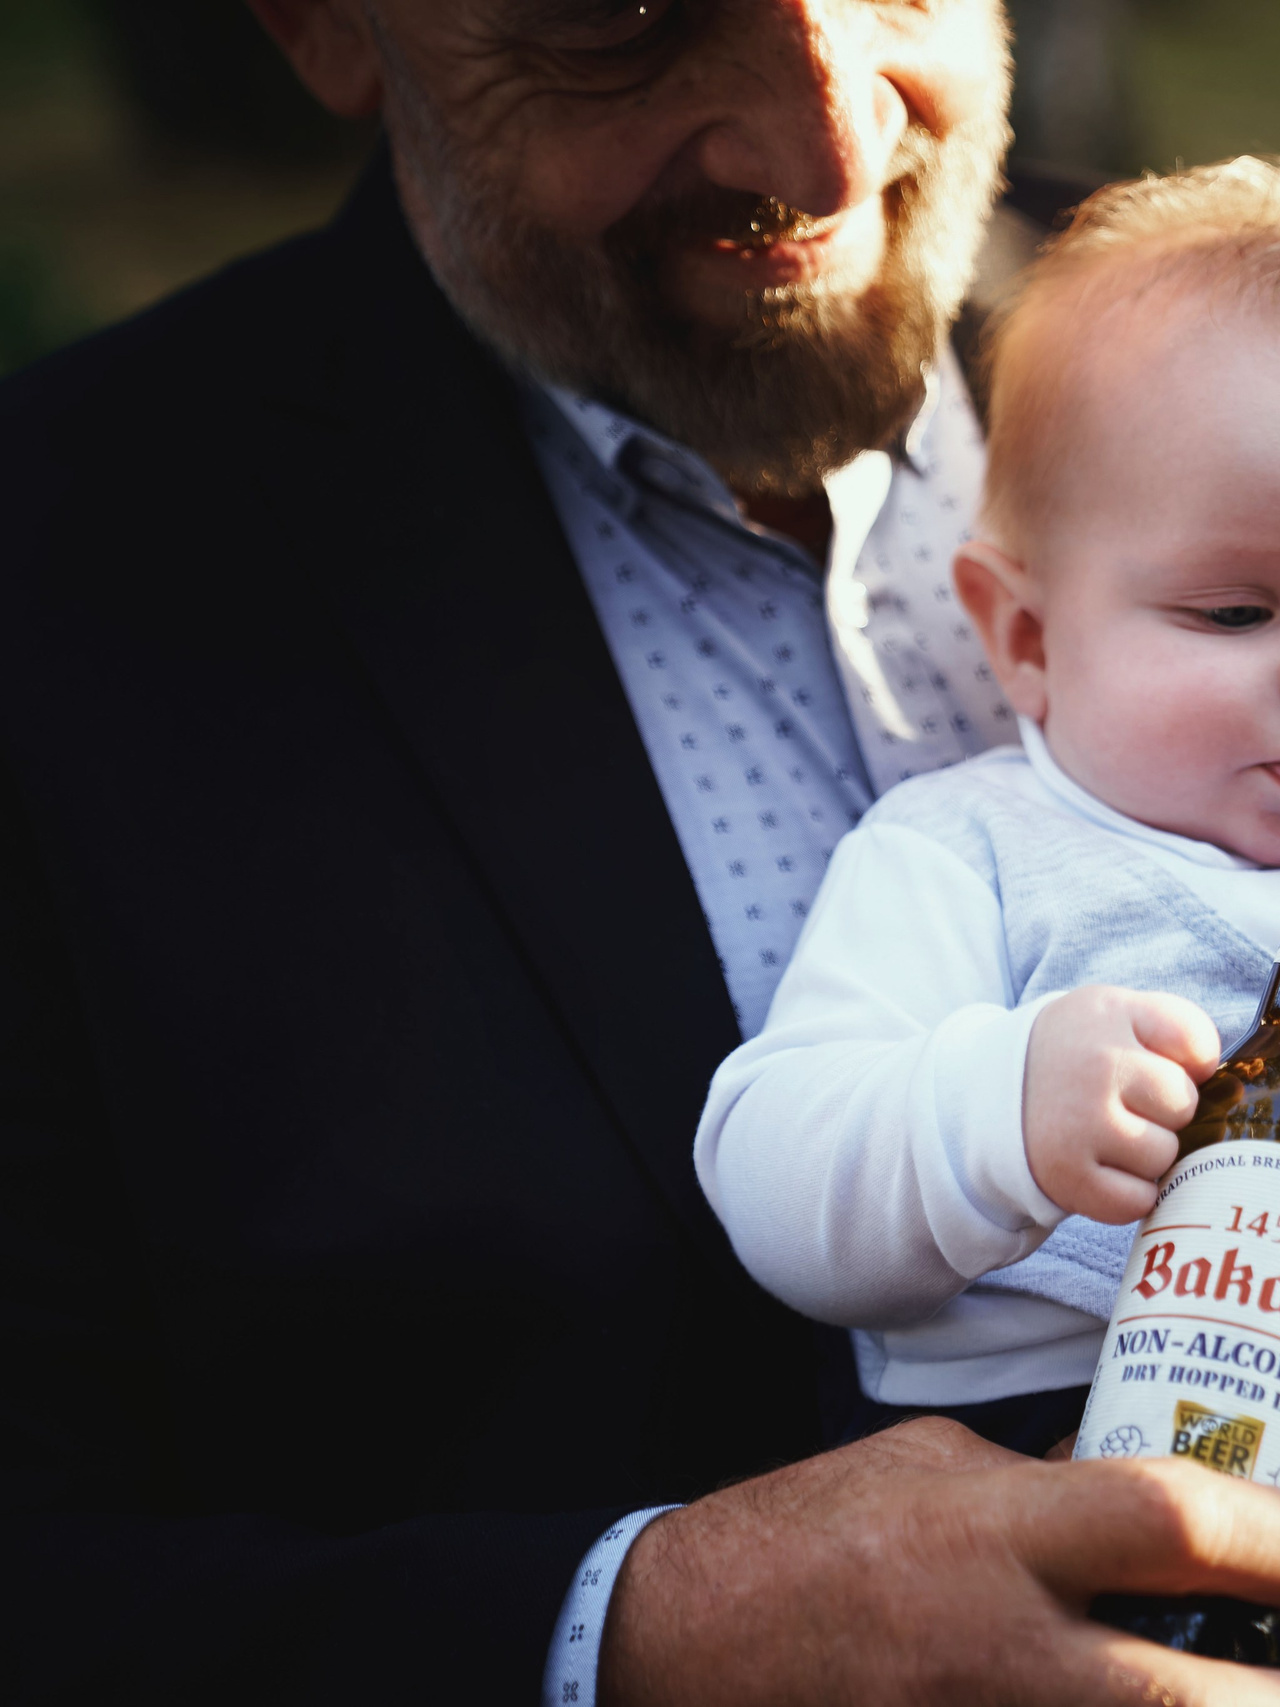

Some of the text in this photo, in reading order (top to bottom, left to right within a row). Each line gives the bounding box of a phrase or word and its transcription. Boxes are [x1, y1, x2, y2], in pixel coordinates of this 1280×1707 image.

[1121, 1364, 1161, 1383] DRY
[1167, 1366, 1266, 1401] HOPPED
[1179, 1412, 1256, 1446] WORLD
[1171, 1429, 1250, 1475] BEER
